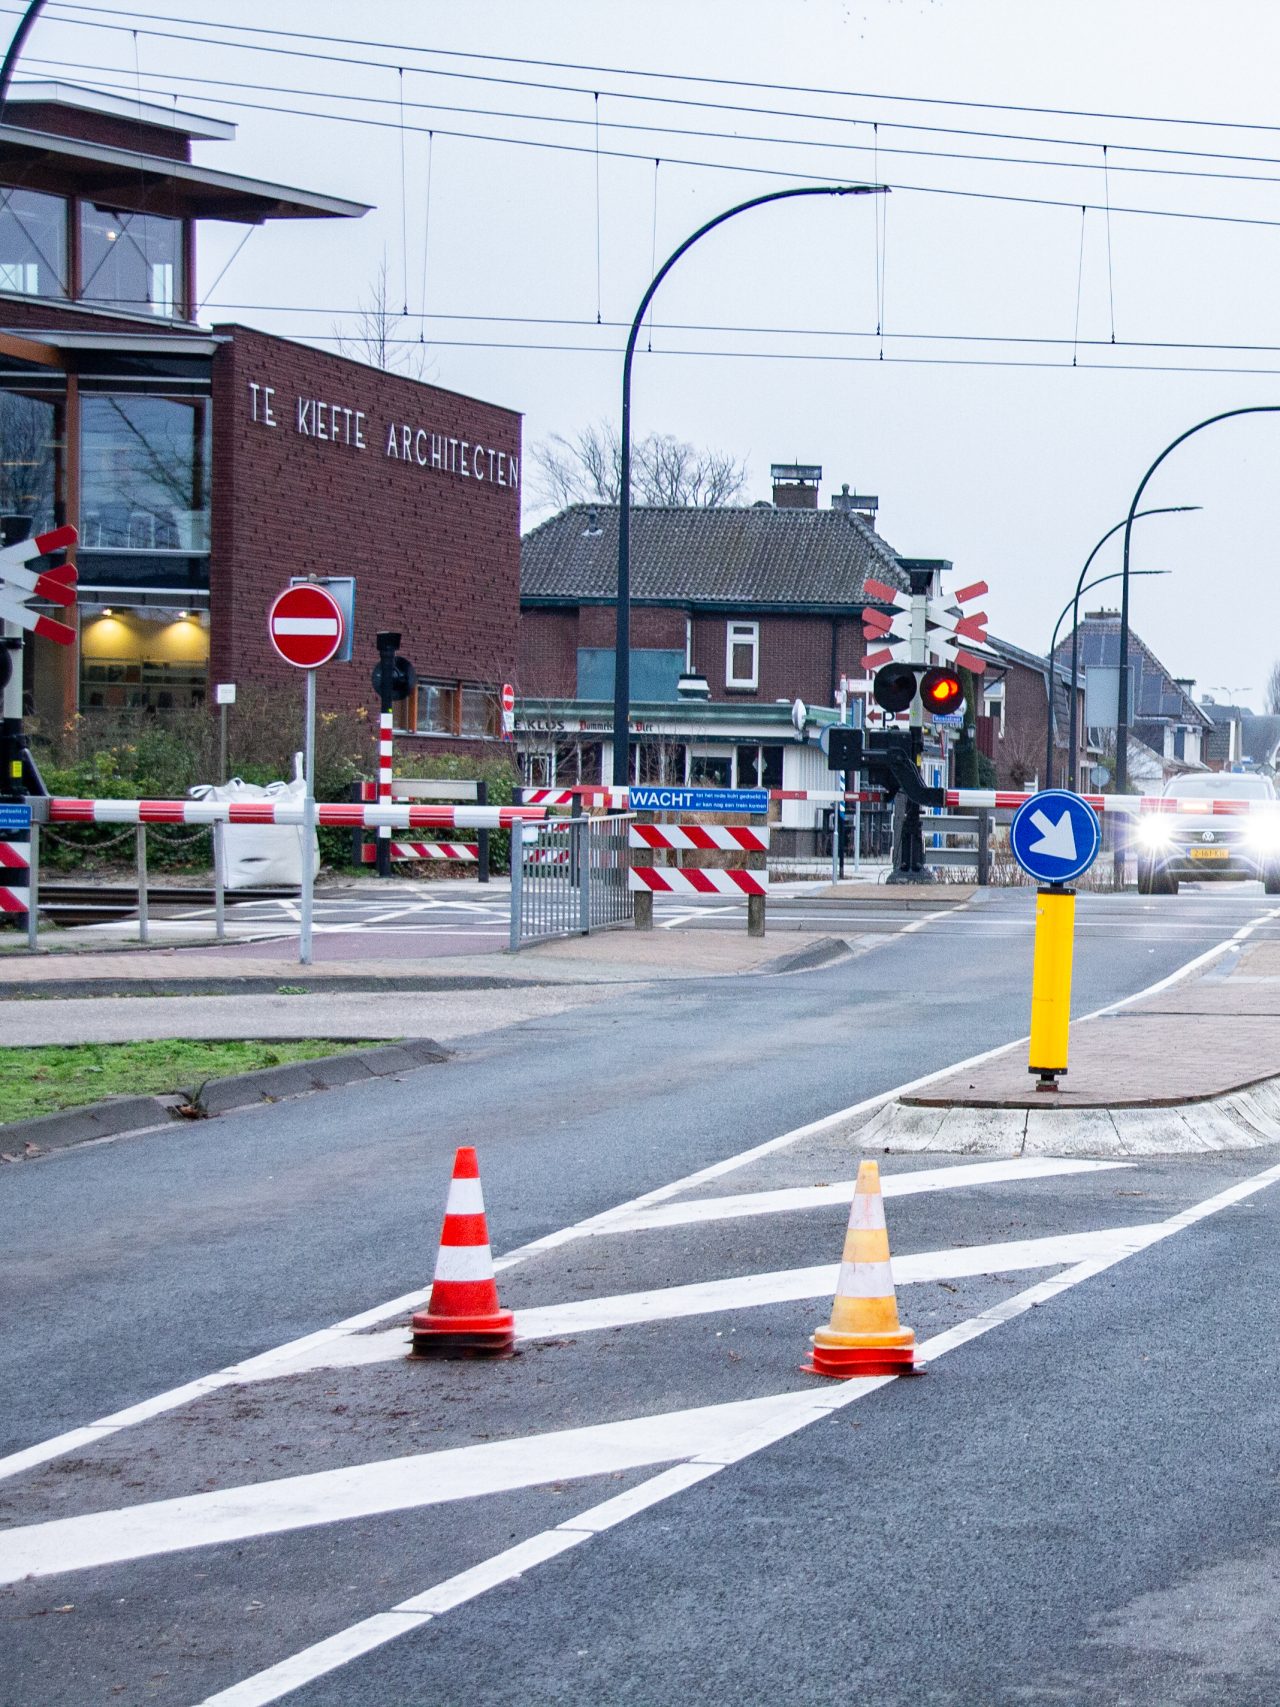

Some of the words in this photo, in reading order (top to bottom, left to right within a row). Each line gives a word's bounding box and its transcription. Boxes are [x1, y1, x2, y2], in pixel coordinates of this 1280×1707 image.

[250, 383, 276, 426] TE
[299, 397, 366, 449] KIEFTE
[387, 423, 518, 488] ARCHITECTEN
[527, 719, 565, 730] KLOS
[631, 791, 693, 807] WACHT
